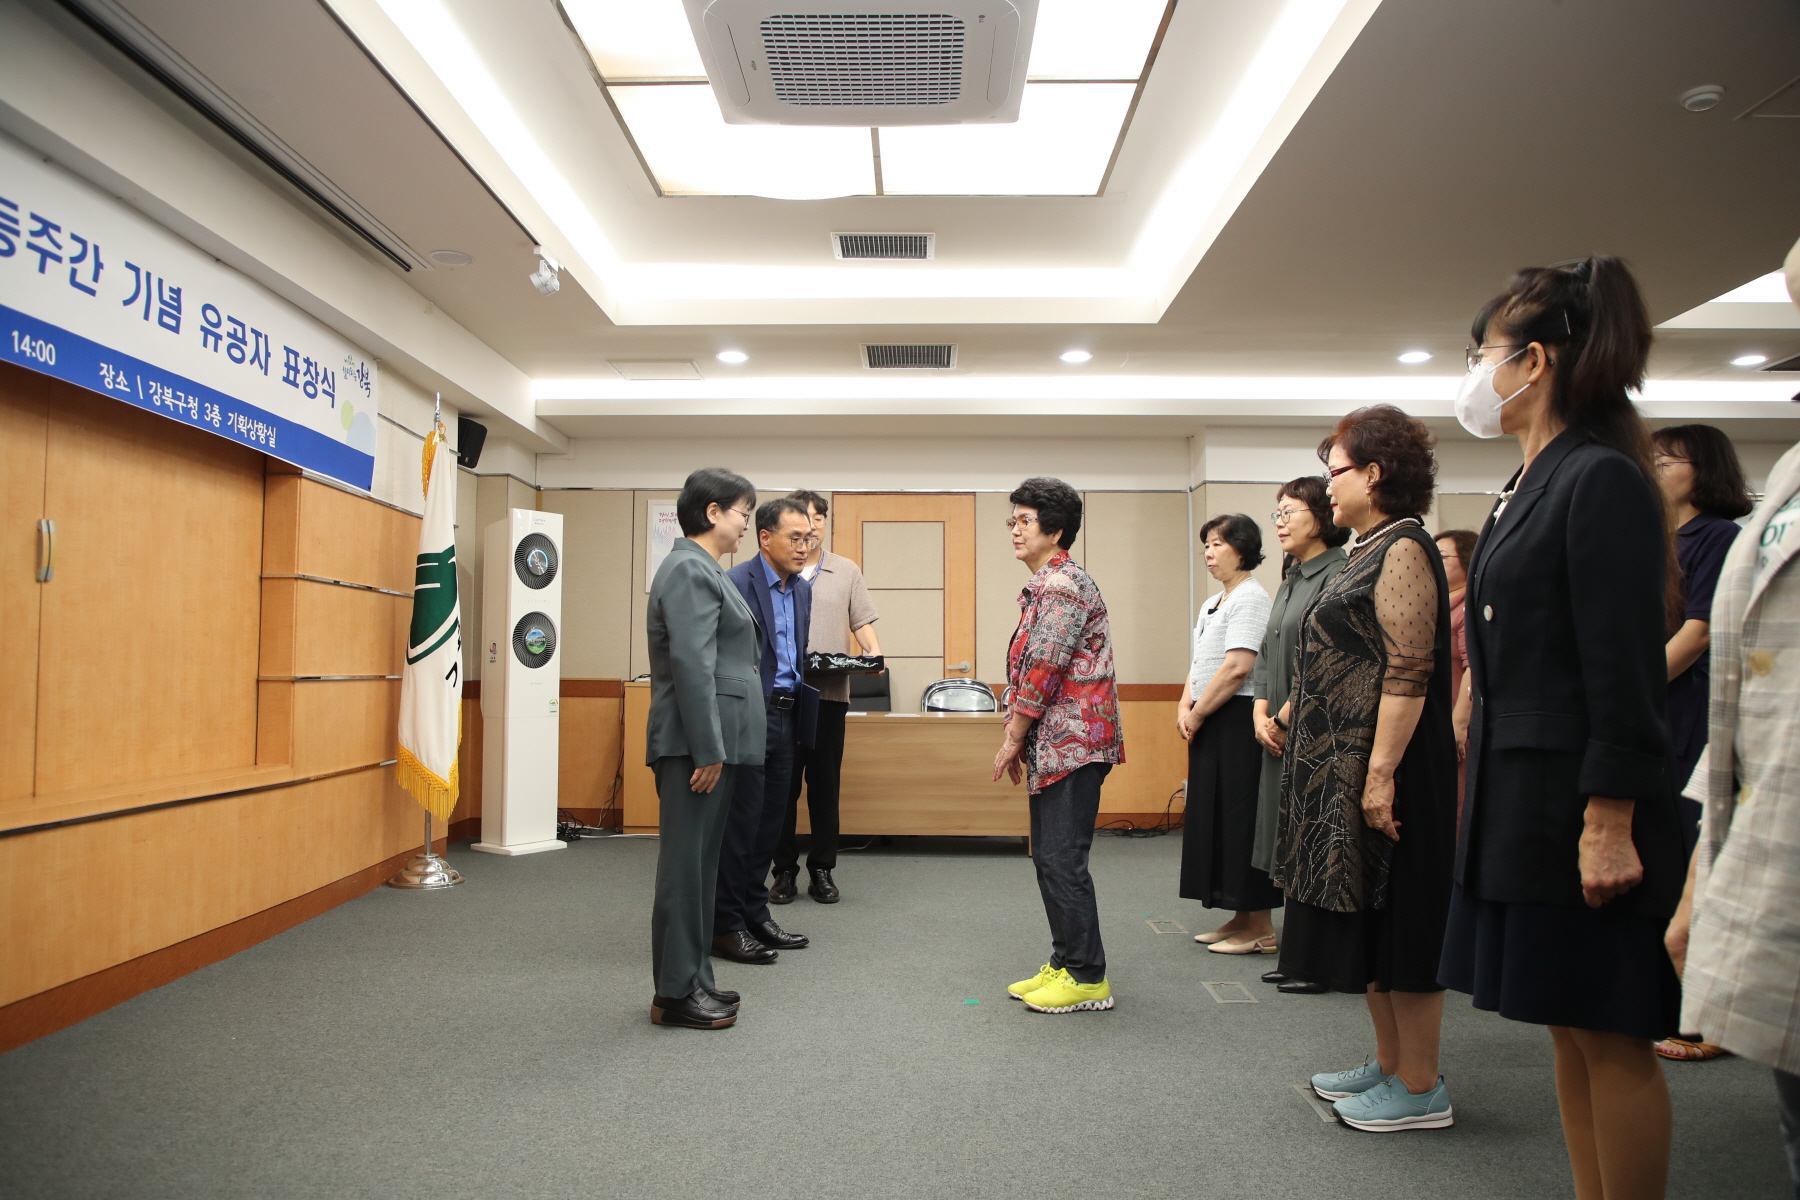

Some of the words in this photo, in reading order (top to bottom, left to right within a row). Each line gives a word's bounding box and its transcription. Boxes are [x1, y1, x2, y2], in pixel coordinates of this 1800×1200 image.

[11, 330, 56, 366] 14:00
[122, 260, 182, 335] 기념
[200, 303, 271, 376] 유공자
[282, 345, 336, 409] 표창식
[99, 362, 131, 393] 장소
[149, 380, 199, 420] 강북구청
[204, 402, 222, 428] 3층
[227, 412, 277, 448] 기획상황실
